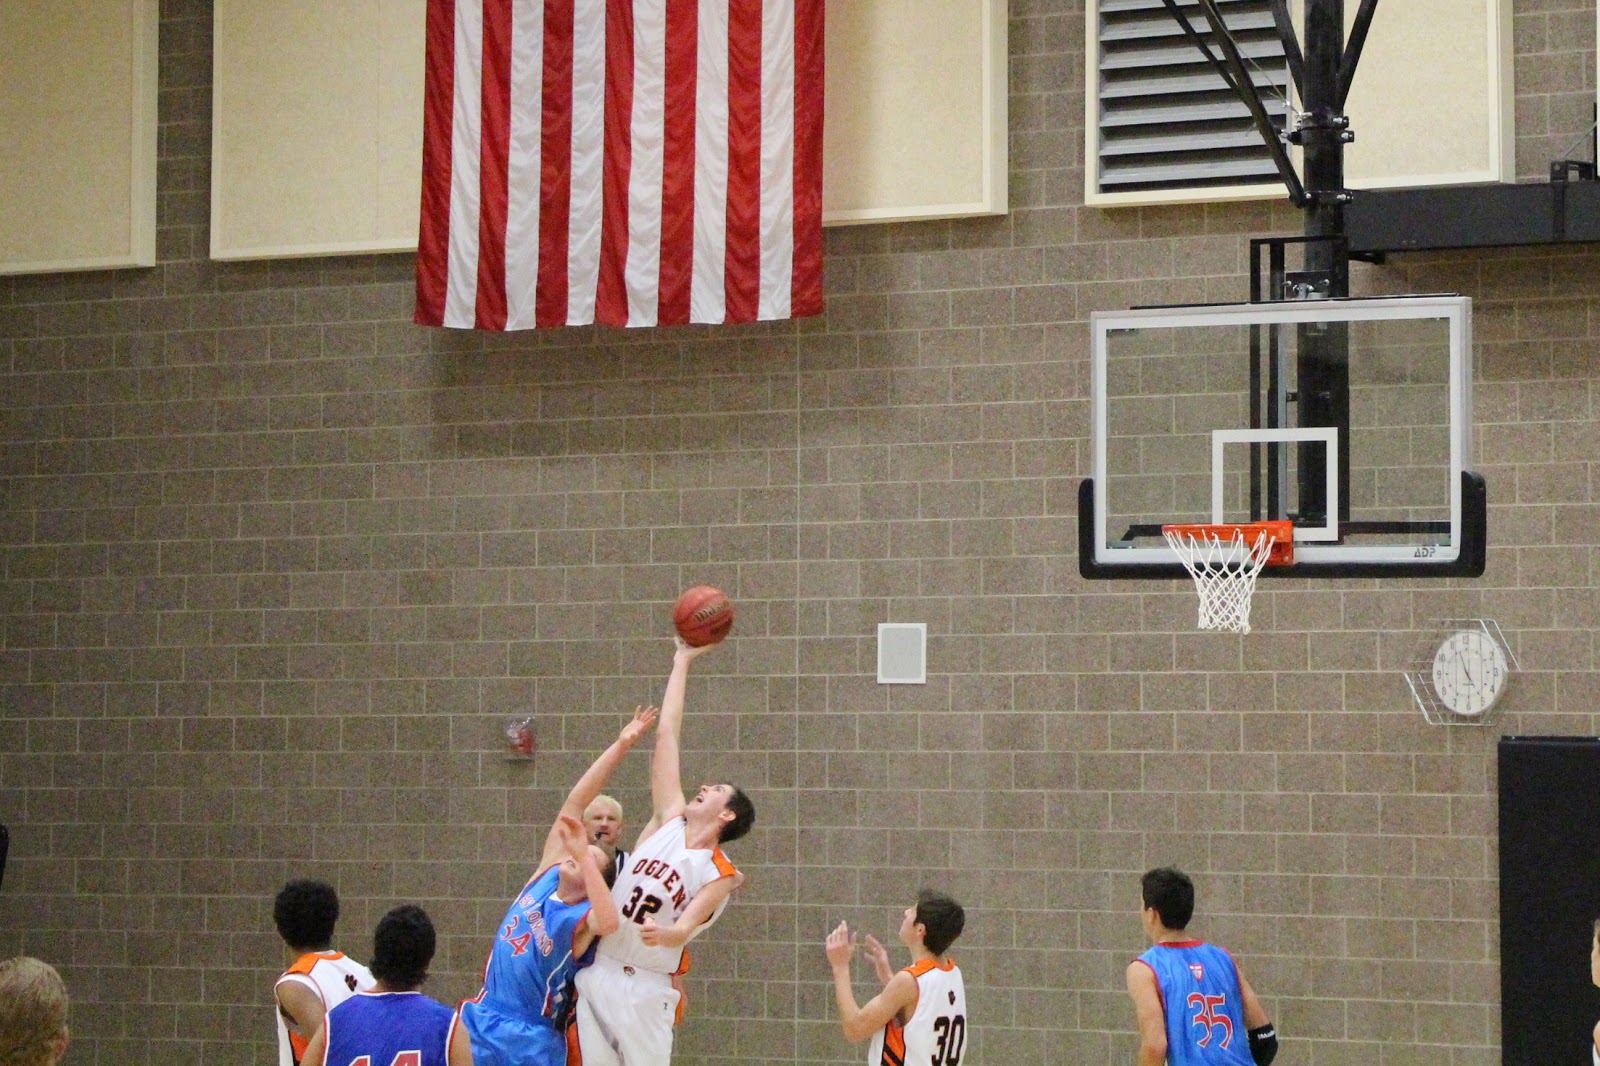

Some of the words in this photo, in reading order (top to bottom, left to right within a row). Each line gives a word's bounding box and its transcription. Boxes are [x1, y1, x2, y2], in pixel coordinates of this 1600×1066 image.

[1414, 547, 1436, 558] ADP
[622, 886, 663, 926] 32
[632, 858, 687, 910] OGDEN
[500, 915, 533, 958] 34
[931, 1014, 965, 1066] 30
[1187, 992, 1233, 1050] 35
